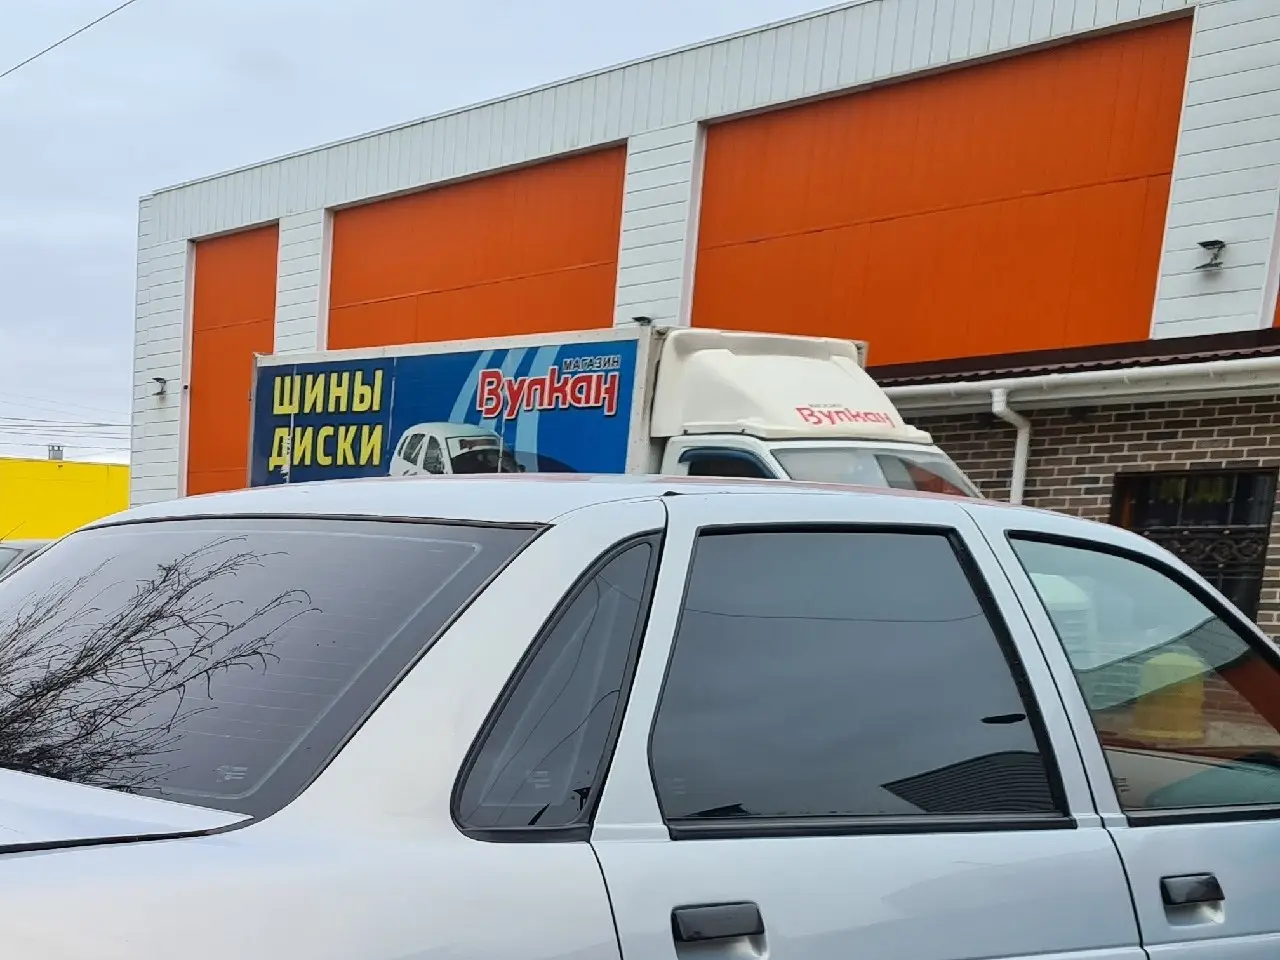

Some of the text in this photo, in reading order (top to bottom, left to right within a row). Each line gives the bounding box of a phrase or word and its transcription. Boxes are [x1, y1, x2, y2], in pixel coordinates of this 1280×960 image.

[563, 355, 621, 371] МАГАЗИН
[273, 370, 383, 415] ШИНЫ
[268, 424, 383, 472] ДИСКИ
